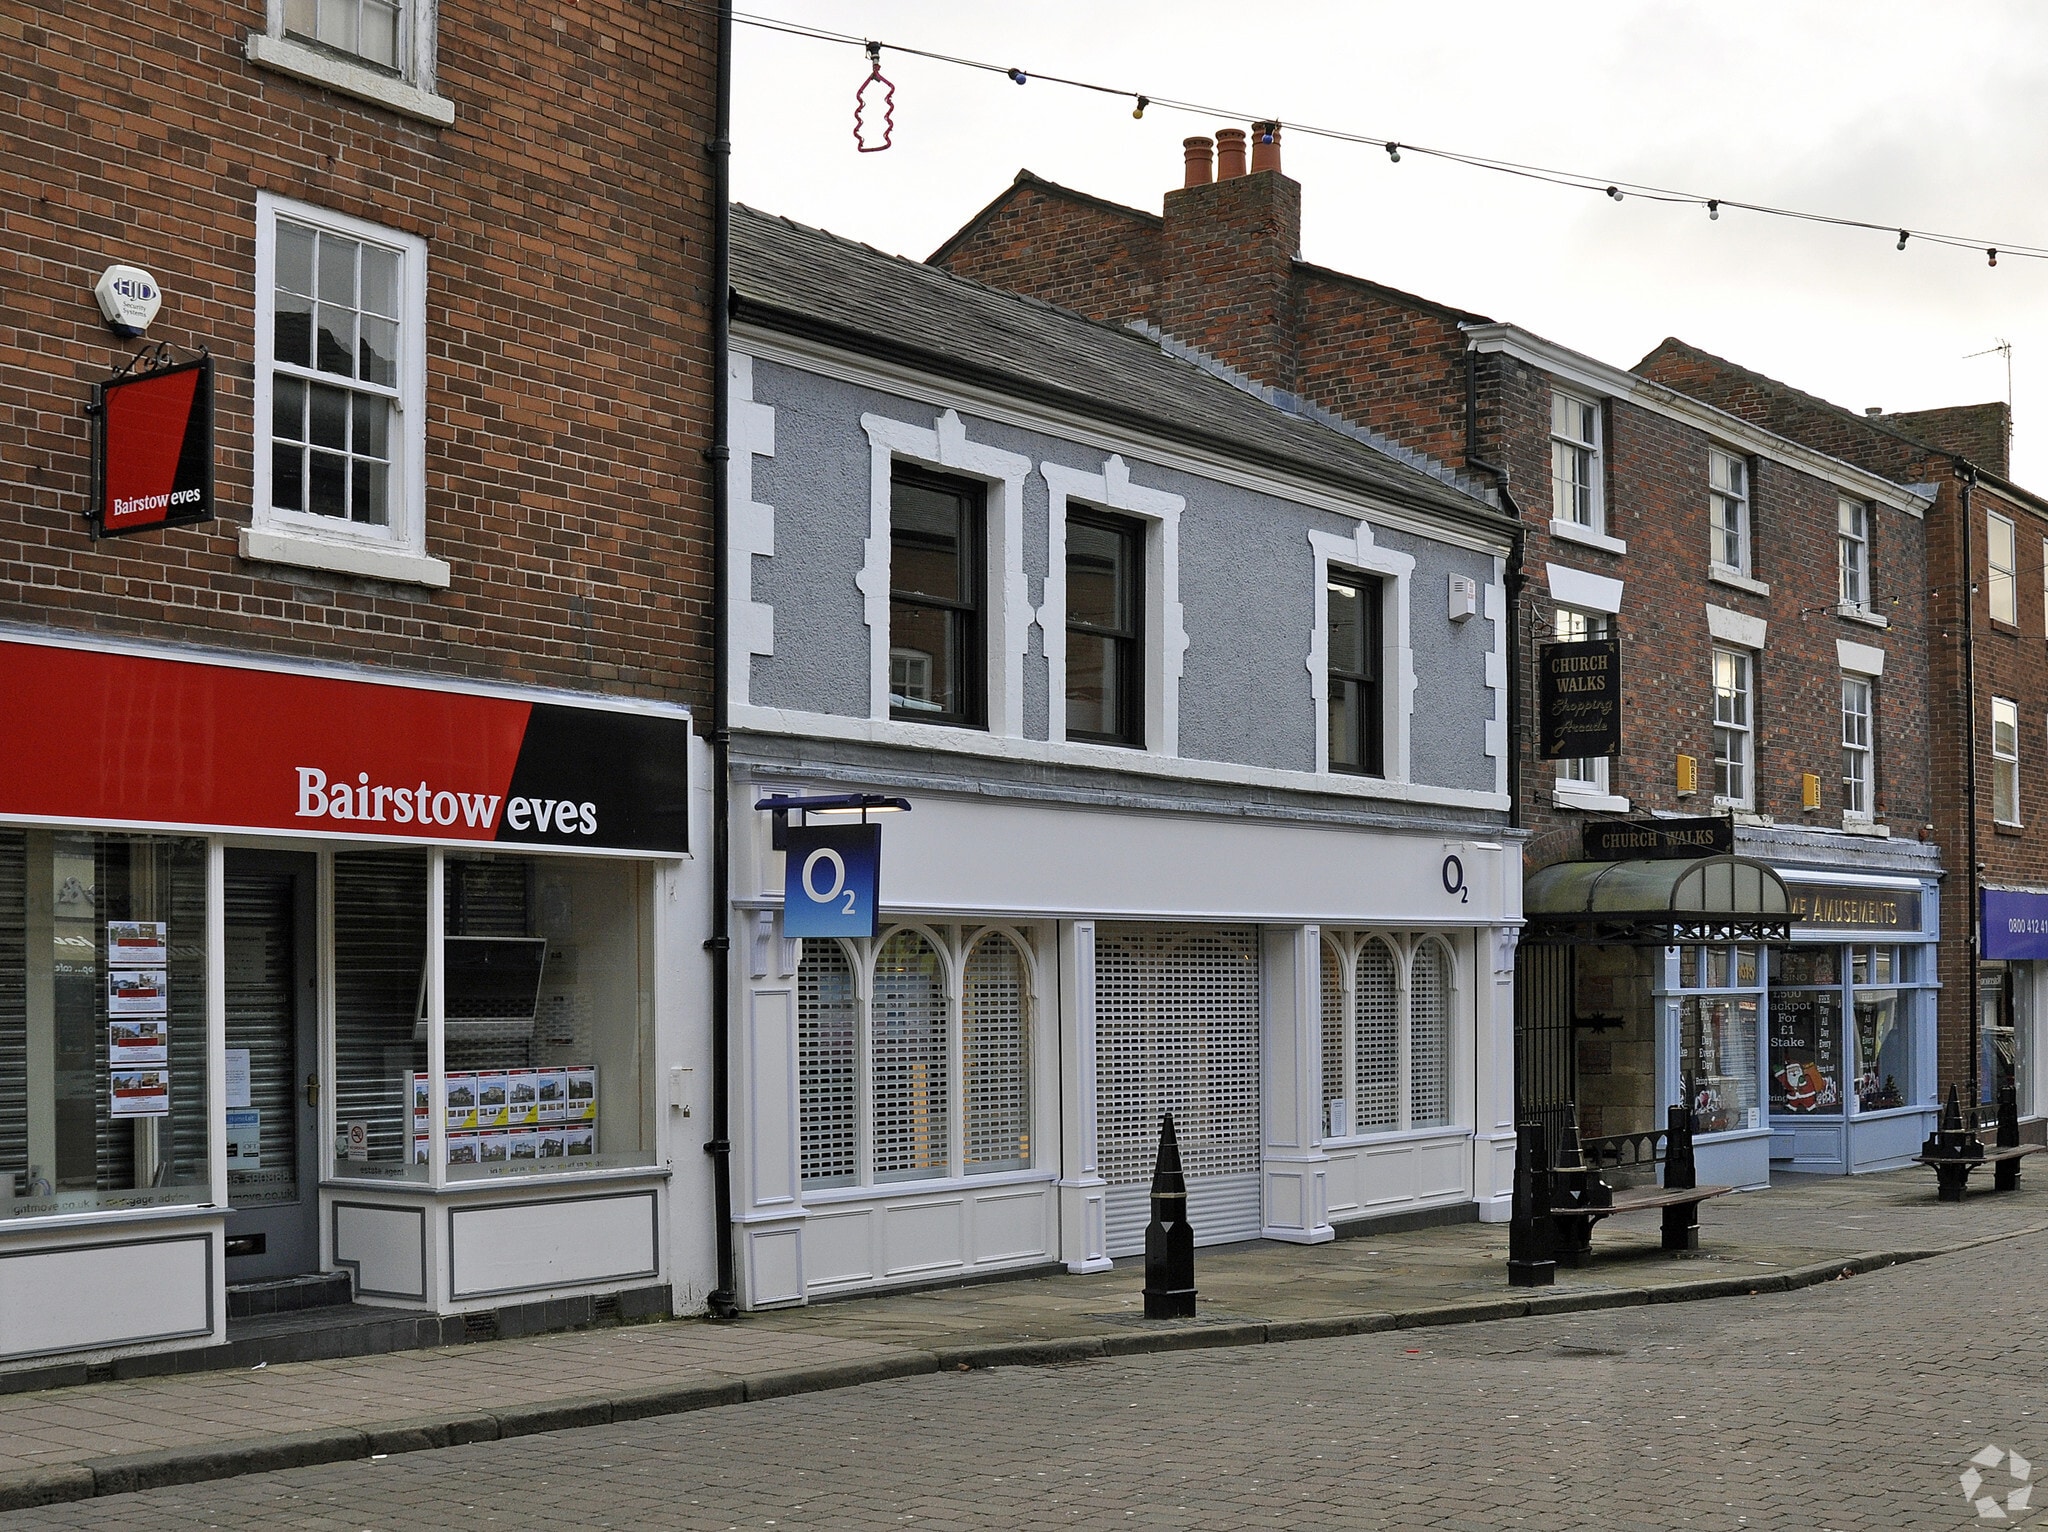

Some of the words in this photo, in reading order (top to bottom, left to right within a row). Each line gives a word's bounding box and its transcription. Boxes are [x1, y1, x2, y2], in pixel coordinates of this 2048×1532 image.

[123, 301, 146, 312] Security
[123, 308, 147, 318] Systems
[113, 493, 170, 516] Bairstow
[171, 488, 201, 505] eves
[1551, 655, 1608, 673] CHURCH
[1556, 675, 1606, 693] WALKS
[1552, 698, 1613, 717] Shopping
[1554, 720, 1608, 738] Arcade
[295, 766, 501, 828] Bairstow
[507, 796, 598, 835] eves
[1602, 832, 1657, 849] CHURCH
[1665, 829, 1714, 847] WALKS
[2008, 918, 2026, 934] 0800
[2026, 919, 2040, 934] 412
[1778, 1013, 1797, 1023] For
[1780, 1025, 1794, 1036] £1
[1820, 1028, 1829, 1038] Day
[1701, 1036, 1713, 1047] Day
[1770, 1037, 1805, 1048] Stake
[1818, 1039, 1831, 1050] Every
[1699, 1048, 1716, 1060] Every
[1820, 1050, 1830, 1060] Day
[1701, 1060, 1713, 1072] Day
